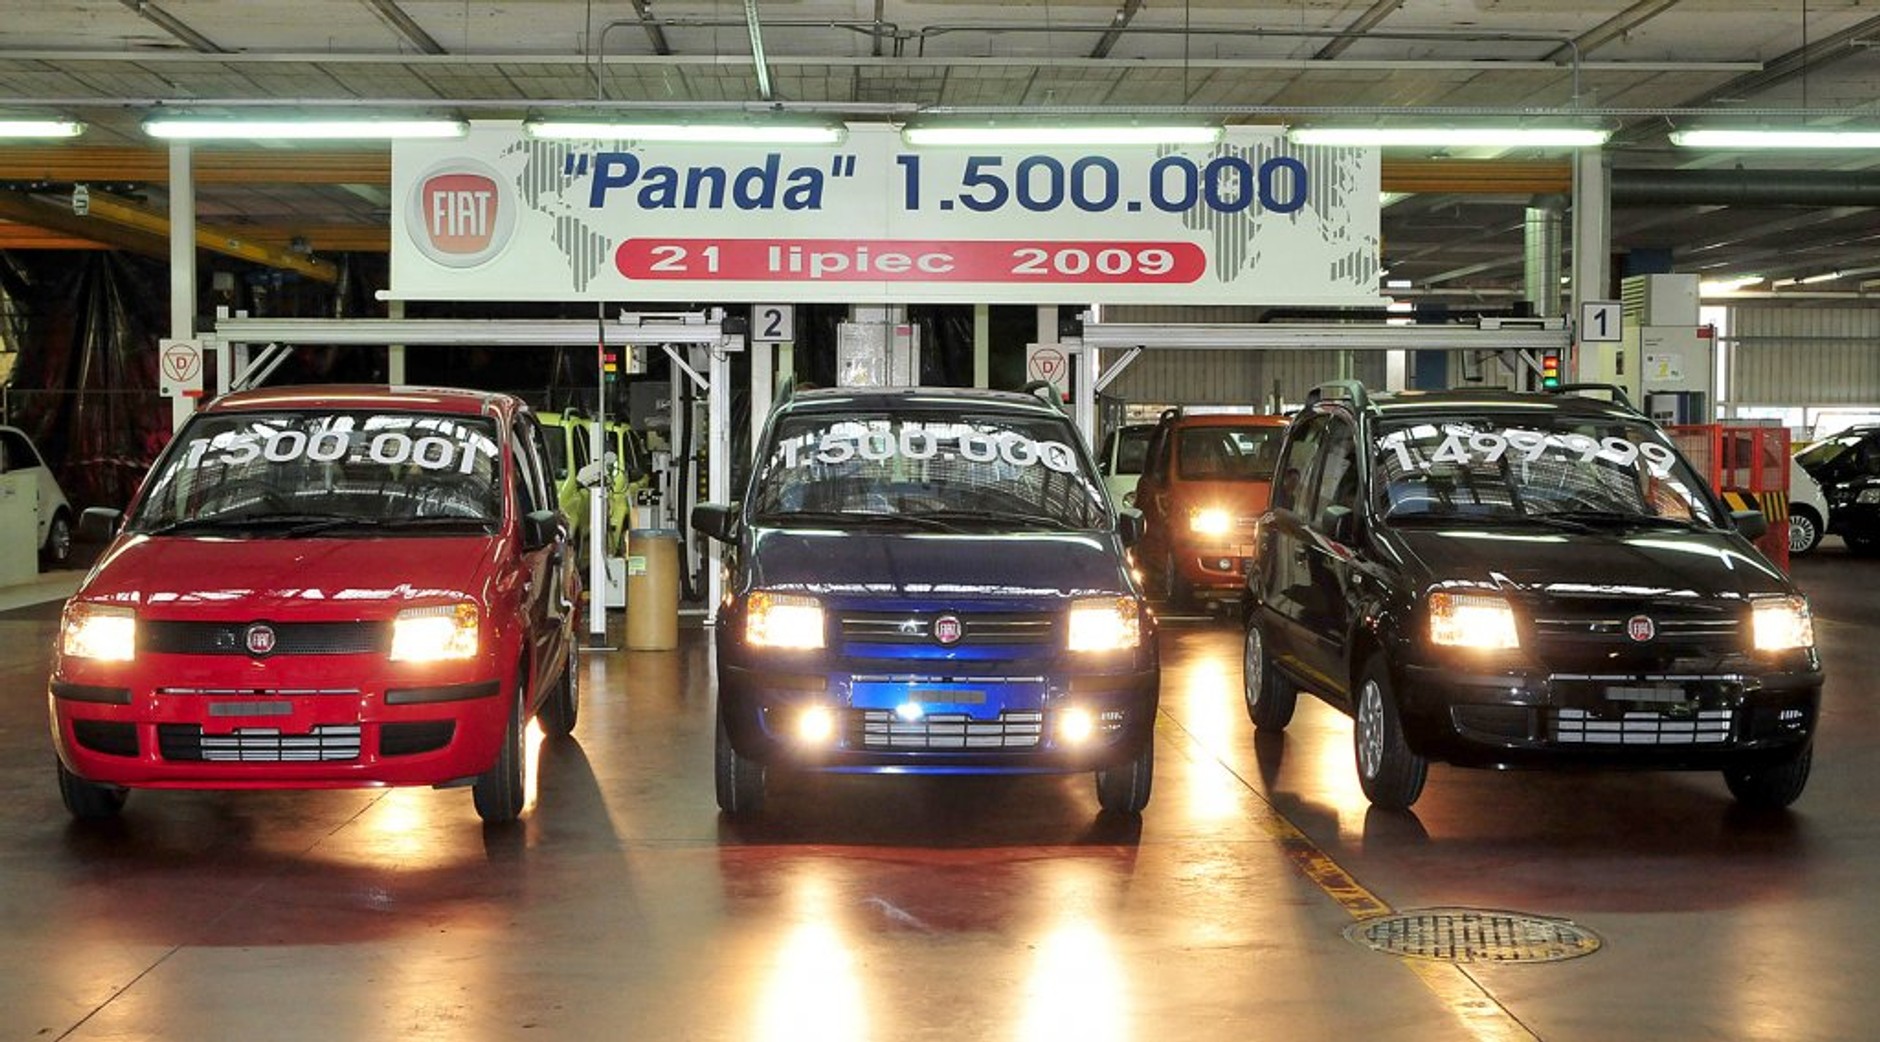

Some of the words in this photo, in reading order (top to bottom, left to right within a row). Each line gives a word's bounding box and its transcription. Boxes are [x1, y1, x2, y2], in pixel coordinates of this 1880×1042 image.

[563, 151, 856, 210] "Panda"
[896, 154, 1308, 213] 1.500.000
[432, 190, 492, 237] FIAT
[650, 246, 719, 272] 21
[768, 246, 955, 278] lipiec
[1011, 248, 1175, 275] 2009
[763, 308, 783, 337] 2
[1593, 308, 1606, 336] 1
[176, 356, 187, 369] D
[1042, 361, 1053, 373] D
[1382, 432, 1676, 476] 1.499.999
